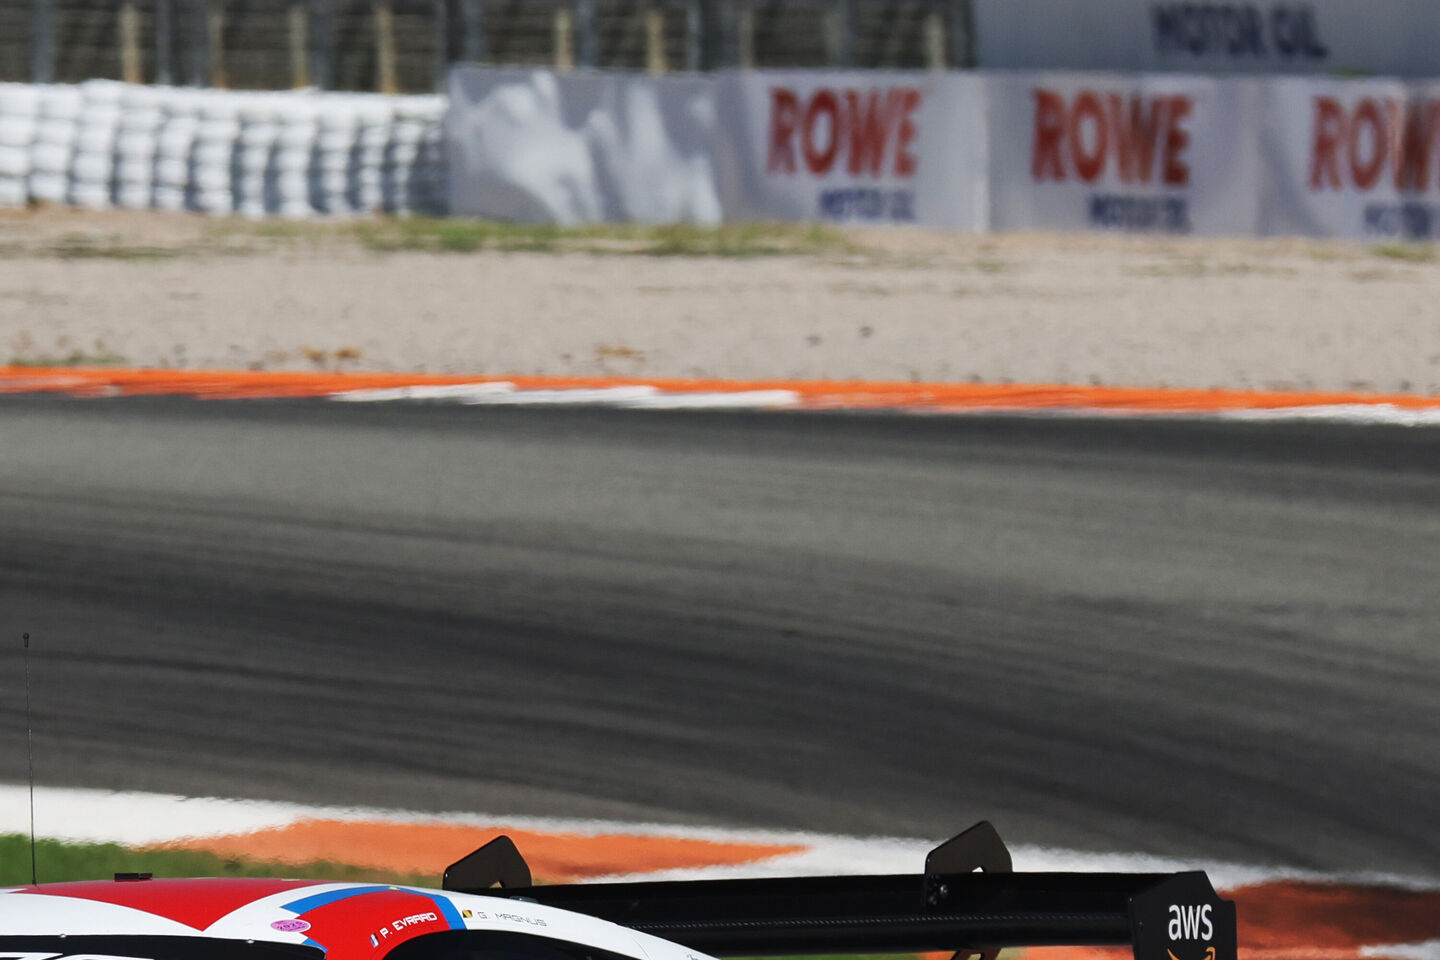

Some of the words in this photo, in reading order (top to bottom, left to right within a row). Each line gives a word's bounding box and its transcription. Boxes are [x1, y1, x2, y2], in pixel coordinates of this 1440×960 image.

[766, 86, 922, 178] ROWE
[1031, 88, 1193, 186] ROWE
[1308, 94, 1440, 193] ROW
[379, 929, 393, 939] P.
[392, 912, 439, 932] EVRARD
[494, 913, 548, 928] MAGNUS
[1167, 904, 1214, 941] aws
